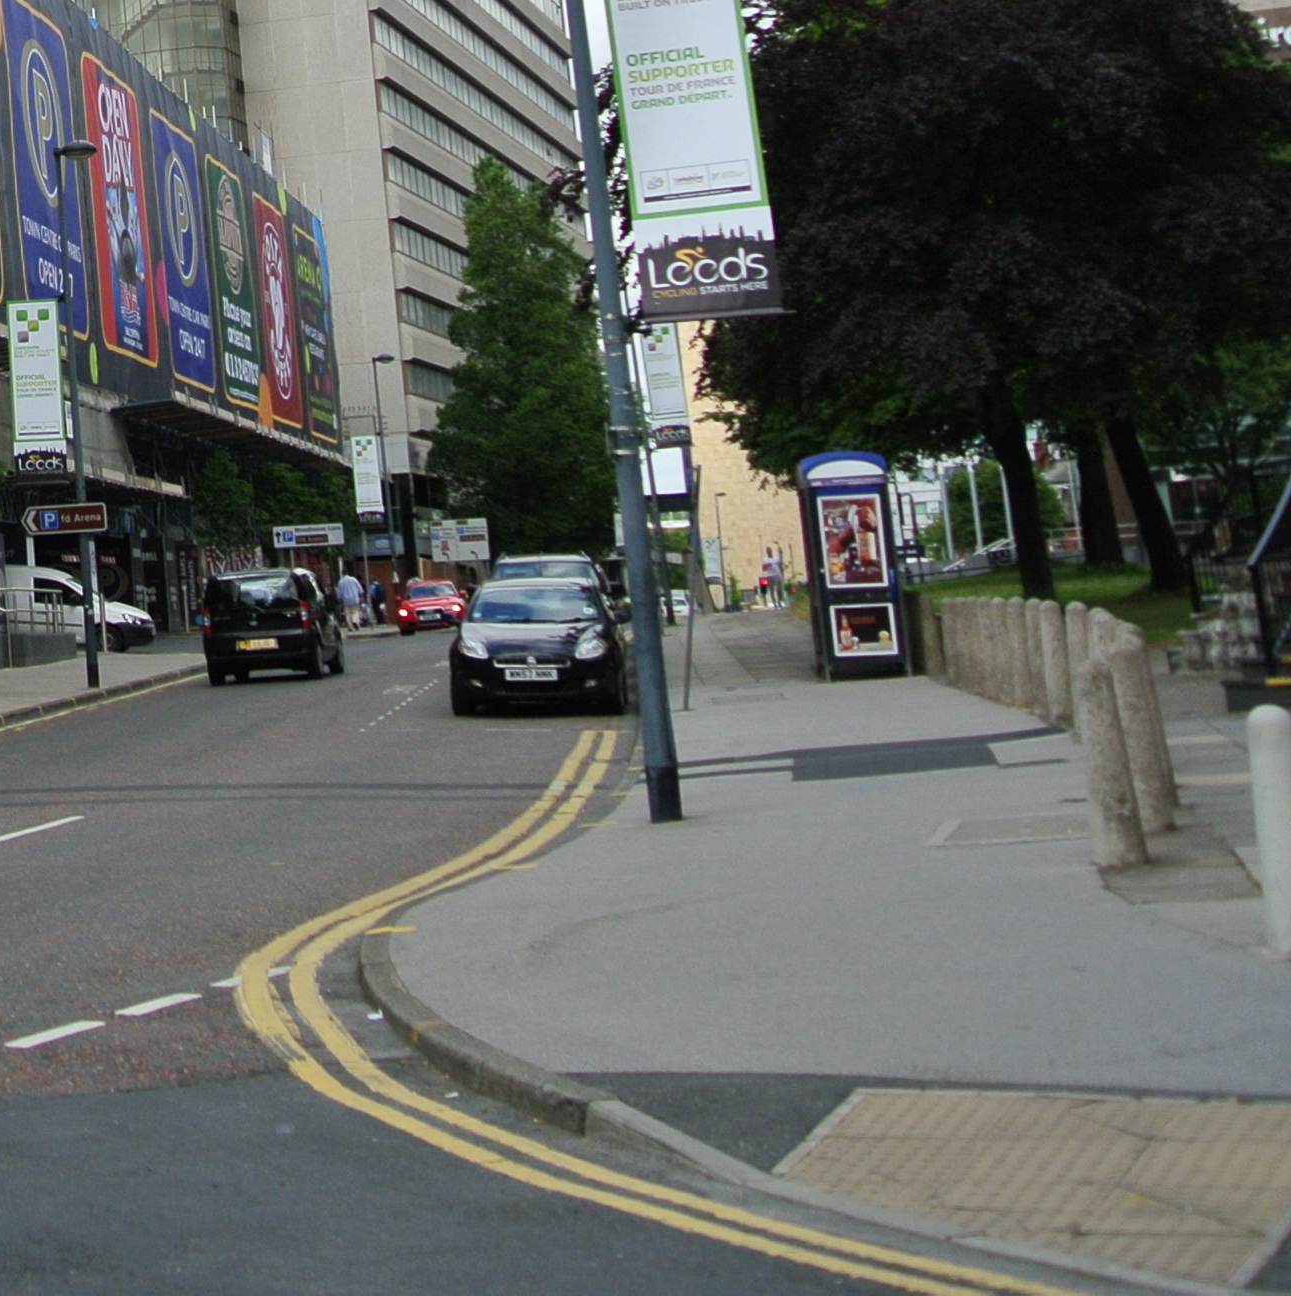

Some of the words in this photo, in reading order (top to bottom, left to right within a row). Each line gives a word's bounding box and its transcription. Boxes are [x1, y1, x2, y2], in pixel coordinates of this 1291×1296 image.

[617, 0, 650, 12] BUILT
[626, 46, 705, 67] OFFICIAL
[627, 58, 736, 84] SUPPORTER
[629, 84, 665, 97] TOUR
[667, 82, 684, 93] DE
[687, 75, 736, 90] FRANCE
[98, 83, 129, 139] OPEN
[631, 96, 675, 110] GRAND
[102, 133, 133, 187] DAILY
[39, 257, 58, 291] OPEN
[652, 287, 698, 299] CYCLING
[700, 283, 739, 295] STARTS
[740, 280, 768, 291] HERE
[73, 512, 101, 523] Arena
